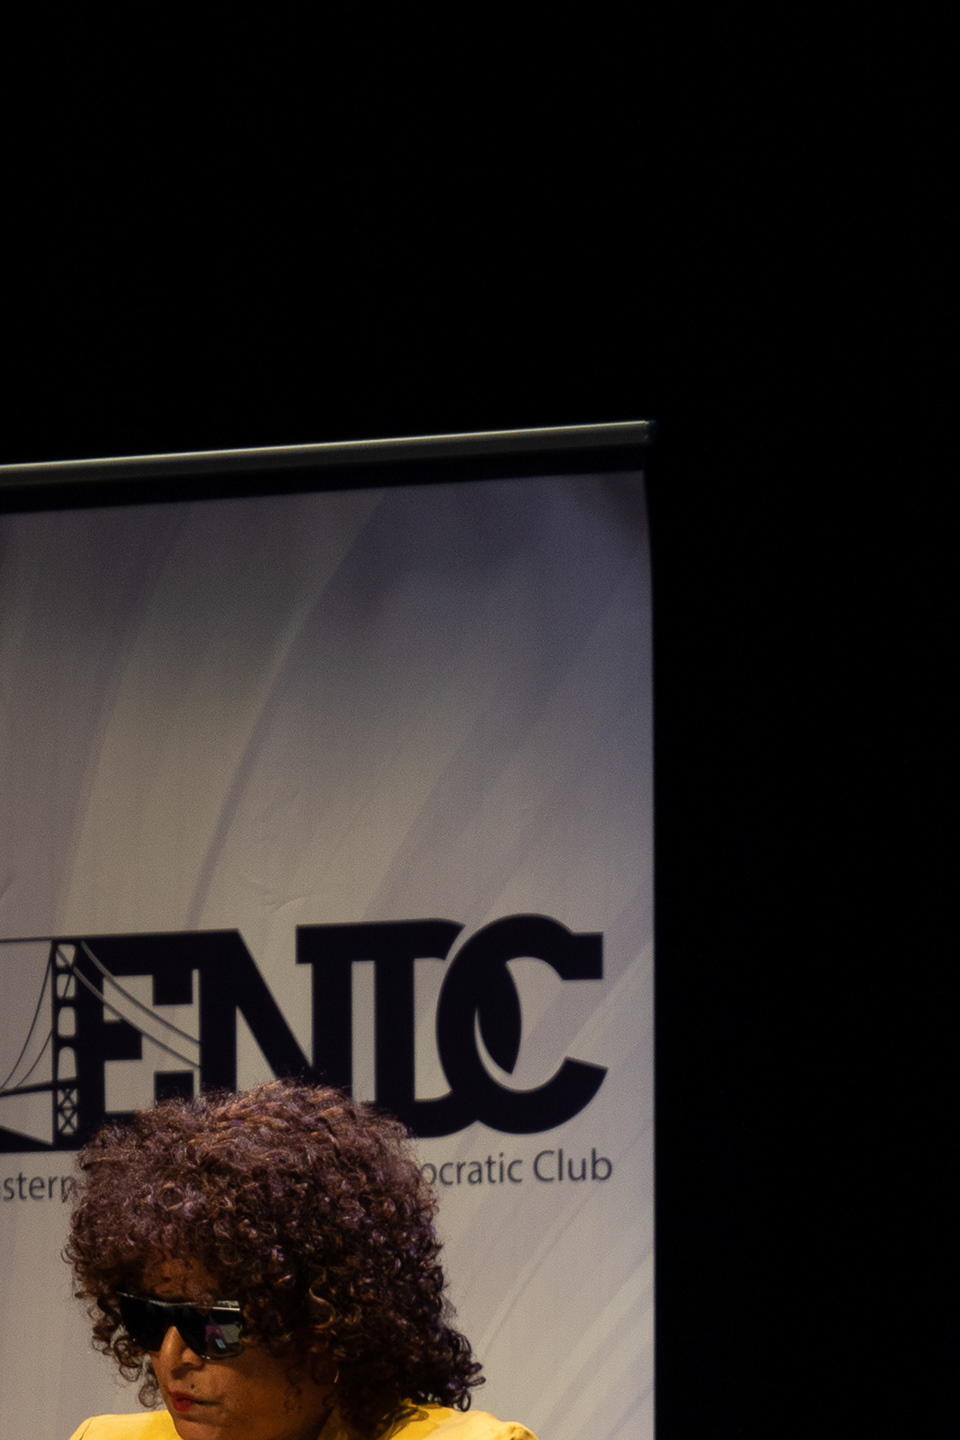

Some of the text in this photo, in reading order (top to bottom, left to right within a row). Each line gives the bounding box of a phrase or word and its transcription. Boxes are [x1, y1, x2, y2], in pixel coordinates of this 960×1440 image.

[3, 1148, 613, 1200] stern ocratic Club
